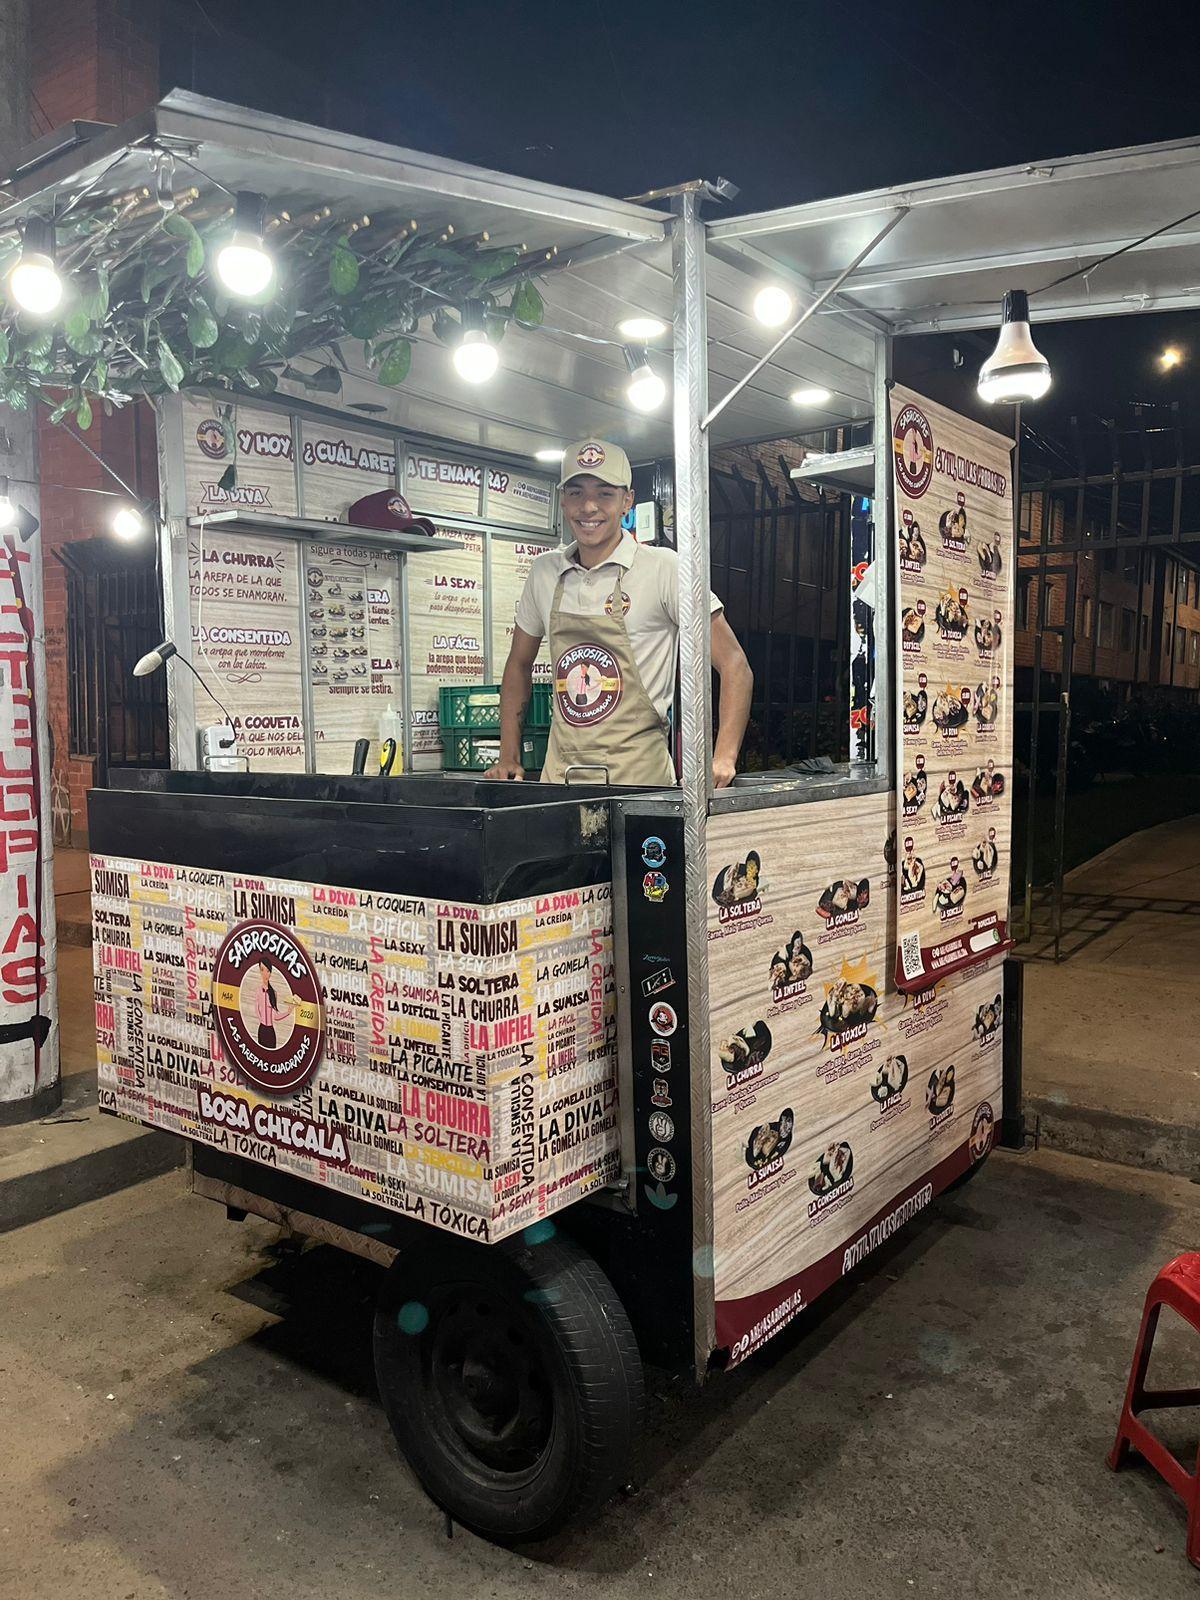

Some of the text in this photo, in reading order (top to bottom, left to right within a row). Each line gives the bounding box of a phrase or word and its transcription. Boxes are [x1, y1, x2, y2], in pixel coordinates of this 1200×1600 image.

[238, 431, 252, 453] Y
[418, 458, 437, 478] TE
[208, 485, 229, 501] LA
[311, 545, 334, 557] sigue
[344, 548, 367, 559] todas
[514, 544, 525, 554] LA
[203, 551, 274, 569] LA CHURRA
[189, 570, 282, 587] LA AREPA DE LA QUE
[434, 575, 476, 590] LA SEXY
[190, 585, 287, 602] TODOS SE ENAMORAN.
[192, 626, 292, 645] LA CONSENTIDA
[433, 634, 479, 651] LA FÁCIL
[210, 648, 231, 659] arepa
[235, 648, 248, 660] que
[249, 647, 285, 658] mordemos
[561, 648, 612, 670] SABROSITAS
[219, 660, 229, 669] con
[231, 659, 242, 669] los
[372, 684, 394, 694] estira.
[244, 717, 299, 729] COQUETA
[249, 732, 264, 741] QUE
[267, 746, 303, 756] MIRARLA.
[94, 869, 130, 898] SUMISA
[176, 869, 225, 888] LA COQUETA
[313, 888, 356, 906] LA DIVA
[360, 894, 426, 917] LA COQUETA
[536, 892, 579, 914] LA DIVA
[94, 909, 131, 927] SOLTERA
[195, 908, 204, 918] LA
[206, 909, 225, 921] SEXY
[234, 890, 296, 926] LA SUMISA
[437, 904, 479, 920] LA DIVA
[720, 900, 761, 919] LA SOLTERA
[143, 921, 184, 937] LA GOMELA
[826, 916, 834, 928] LA
[102, 927, 131, 948] CHURRA
[384, 938, 425, 956] LA SEXY
[437, 919, 518, 957] LA SUMISA
[102, 945, 142, 972] LA INFIEL
[143, 949, 185, 968] LA SUMISA
[228, 930, 307, 978] SABROSITAS
[315, 952, 368, 974] LA GOMELA
[537, 956, 589, 982] LA GOMELA
[438, 972, 519, 996] LA SOLTERA
[774, 981, 806, 1000] LA INFIEL
[331, 988, 369, 1008] SUMISA
[537, 990, 589, 1018] LA SUMISA
[300, 1009, 314, 1020] 2020
[388, 1000, 440, 1021] LA DIFÍCIL
[451, 995, 519, 1022] LA CHURRA
[470, 1022, 489, 1051] LA
[493, 1014, 534, 1049] INFIEL
[227, 1017, 310, 1074] LAS AREPAS CUADRADAS
[389, 1035, 440, 1056] LA INFIEL
[831, 1036, 841, 1050] LA
[147, 1046, 199, 1077] LA DIVA
[391, 1048, 473, 1083] LA PICANTE
[397, 1070, 474, 1099] LA CONSENTIDA
[727, 1063, 762, 1087] LA CHURRA
[319, 1096, 387, 1135] LA DIVA
[402, 1084, 490, 1138] LA CHURRA
[520, 1042, 535, 1189] LA CONSENTIDA
[540, 1093, 584, 1119] LA GOMELA
[200, 1091, 347, 1162] BOSA CHICALA
[539, 1099, 602, 1145] LA DIVA
[387, 1115, 490, 1164] LA SOLTERA
[749, 1175, 758, 1187] LA
[405, 1194, 490, 1243] LA TÓXICA
[808, 1204, 817, 1216] LA
